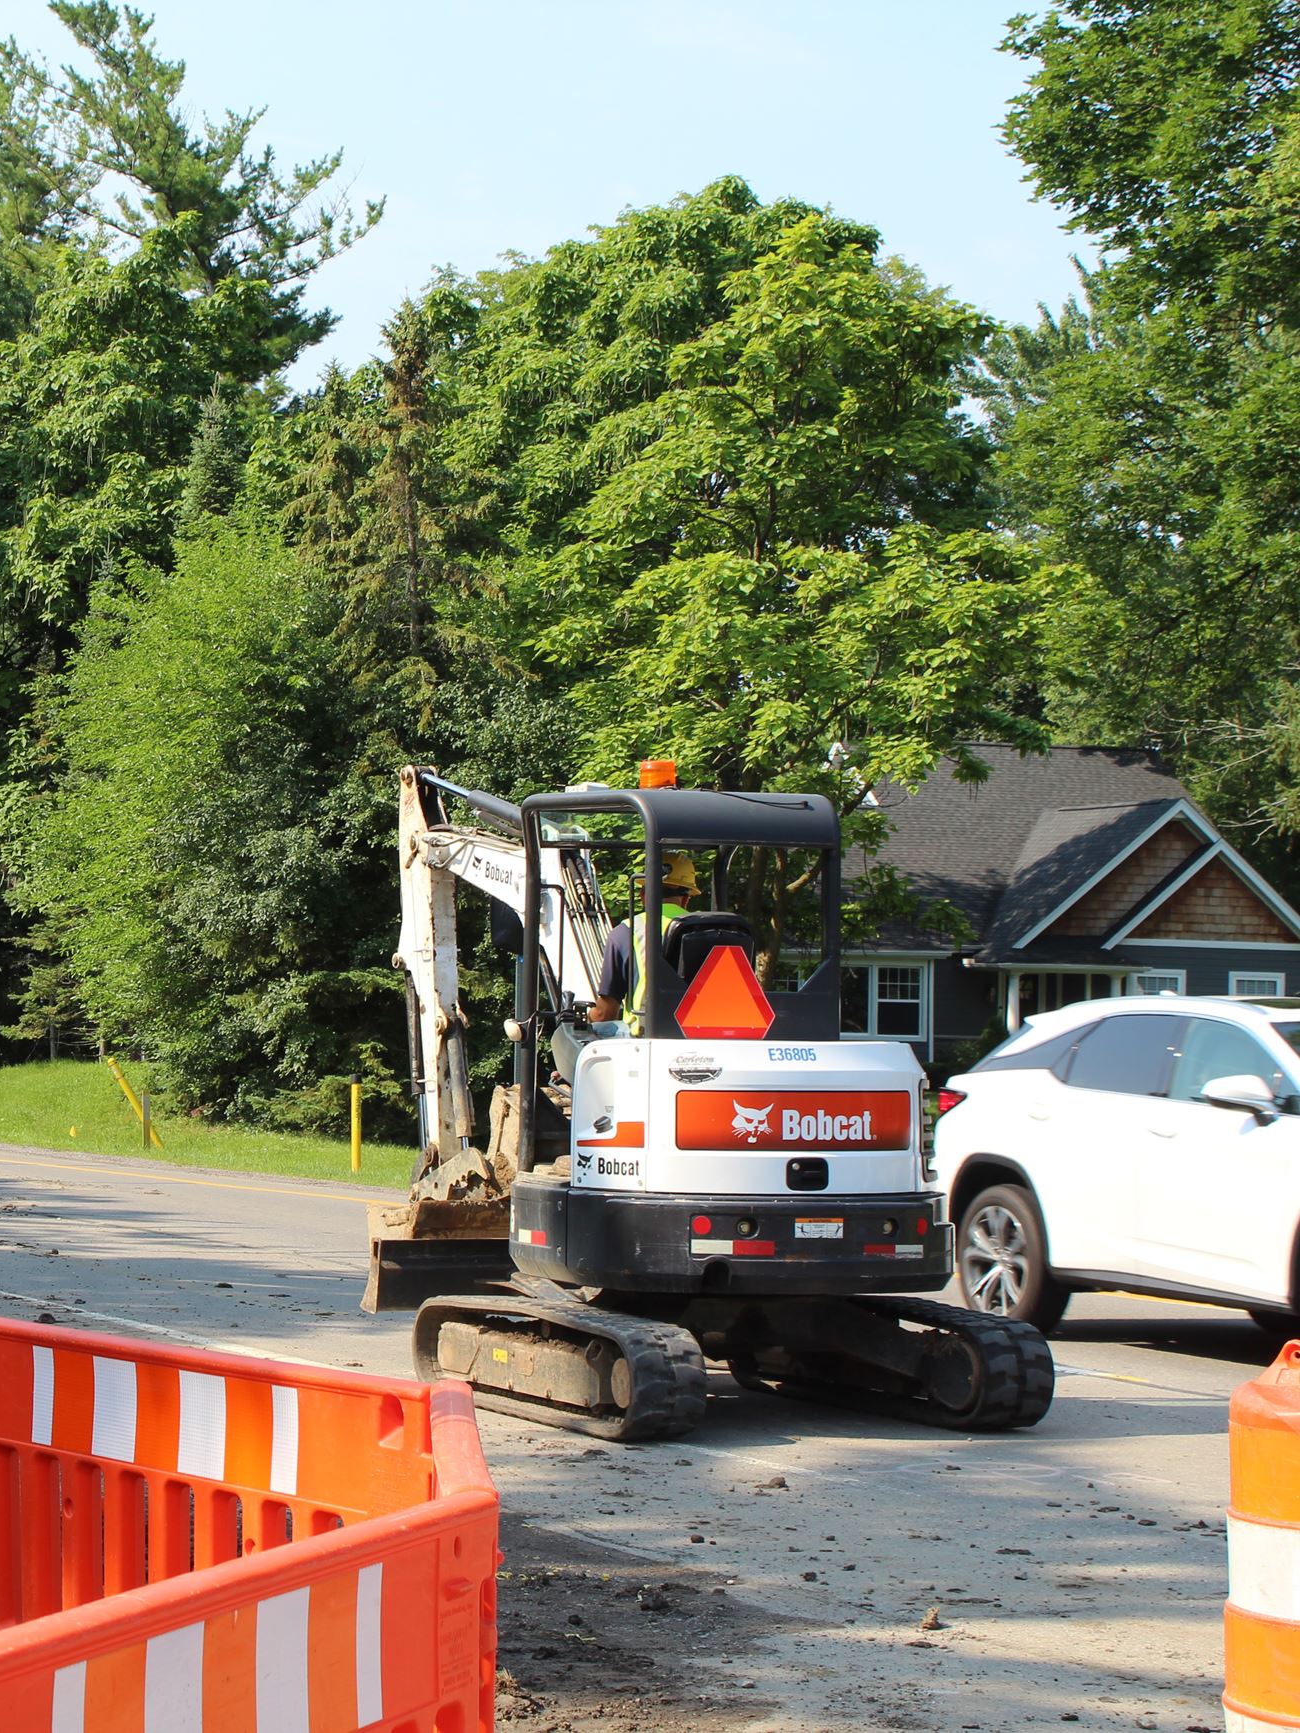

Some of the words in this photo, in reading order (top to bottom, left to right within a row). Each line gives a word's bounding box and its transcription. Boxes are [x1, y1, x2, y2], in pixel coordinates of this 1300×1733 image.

[485, 861, 512, 885] Bobcat
[768, 1048, 817, 1062] E36805
[782, 1109, 872, 1141] Bobcat
[597, 1157, 640, 1176] Bobcat
